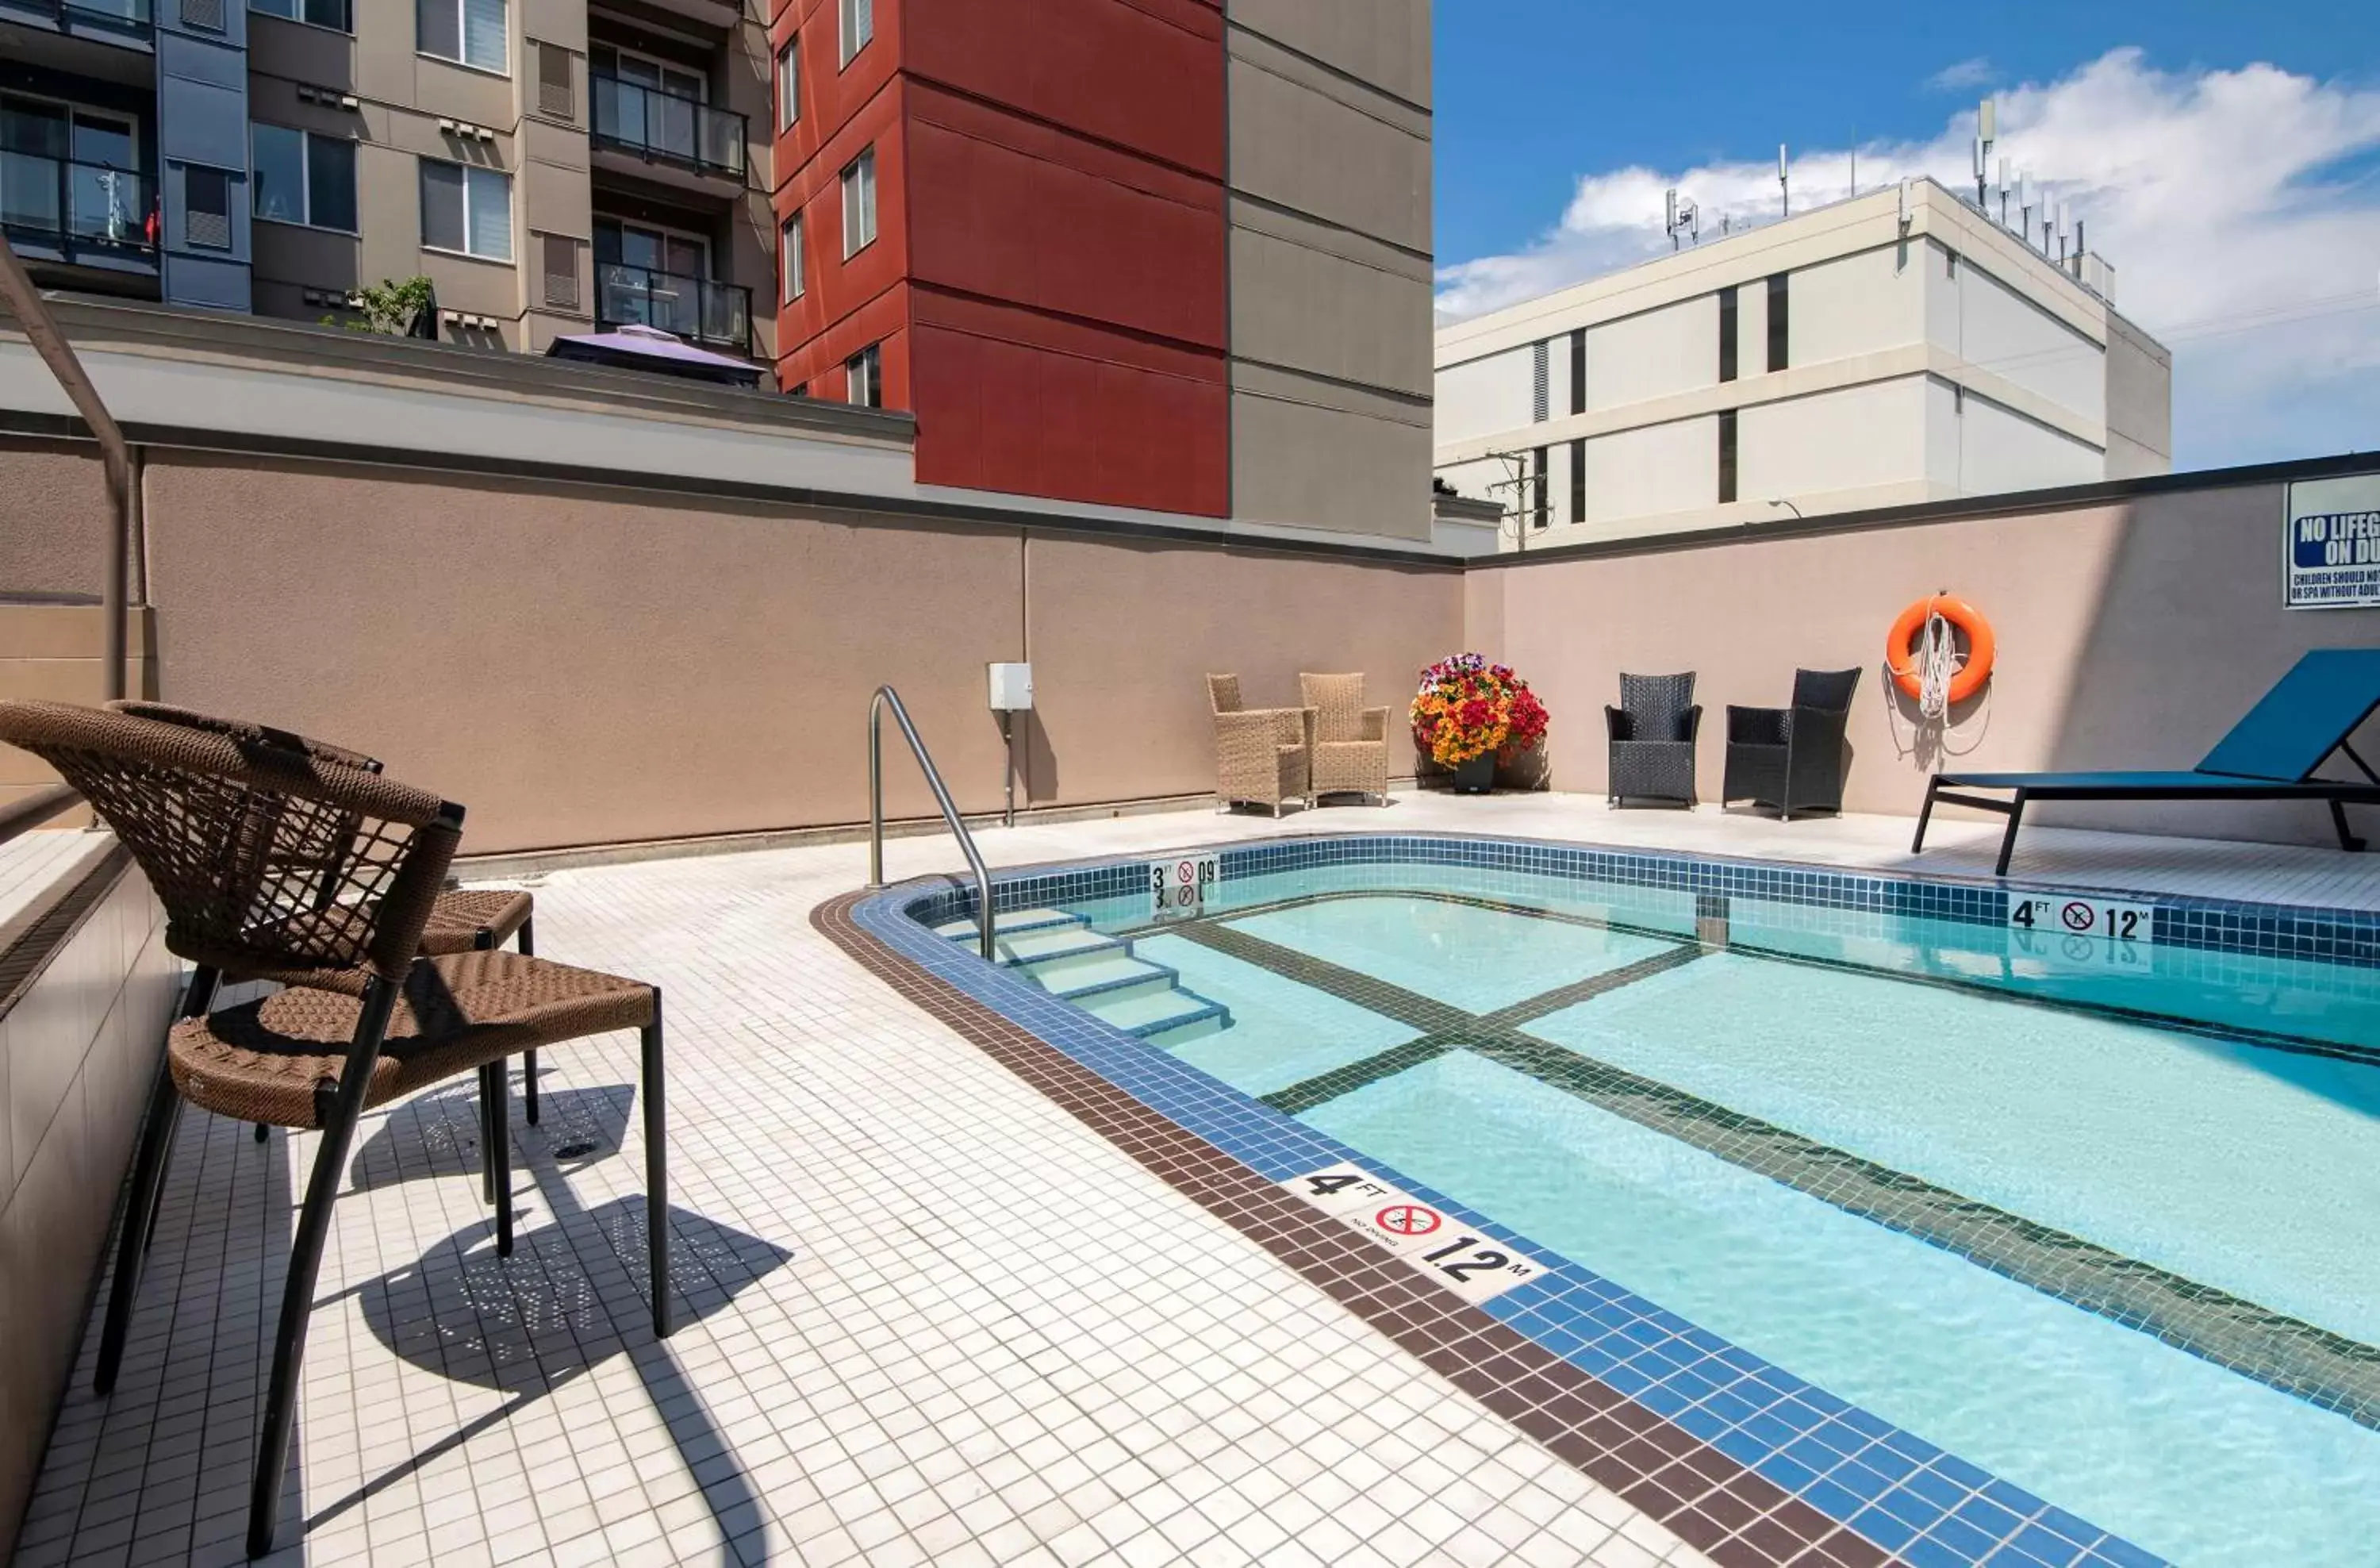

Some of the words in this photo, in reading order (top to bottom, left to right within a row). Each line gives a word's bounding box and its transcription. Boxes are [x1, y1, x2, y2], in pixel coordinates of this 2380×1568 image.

[2301, 517, 2326, 542] NO
[2325, 540, 2351, 565] ON
[2294, 572, 2332, 586] CHILDREN
[2333, 571, 2364, 584] SHOULD
[2304, 586, 2318, 599] SPA
[2320, 585, 2357, 598] WITHOUT
[1153, 867, 1164, 888] 3
[2013, 901, 2035, 930] 4
[2035, 902, 2051, 913] FT
[1306, 1175, 1365, 1196] 4
[1355, 1183, 1388, 1197] FT
[1507, 1263, 1532, 1277] M
